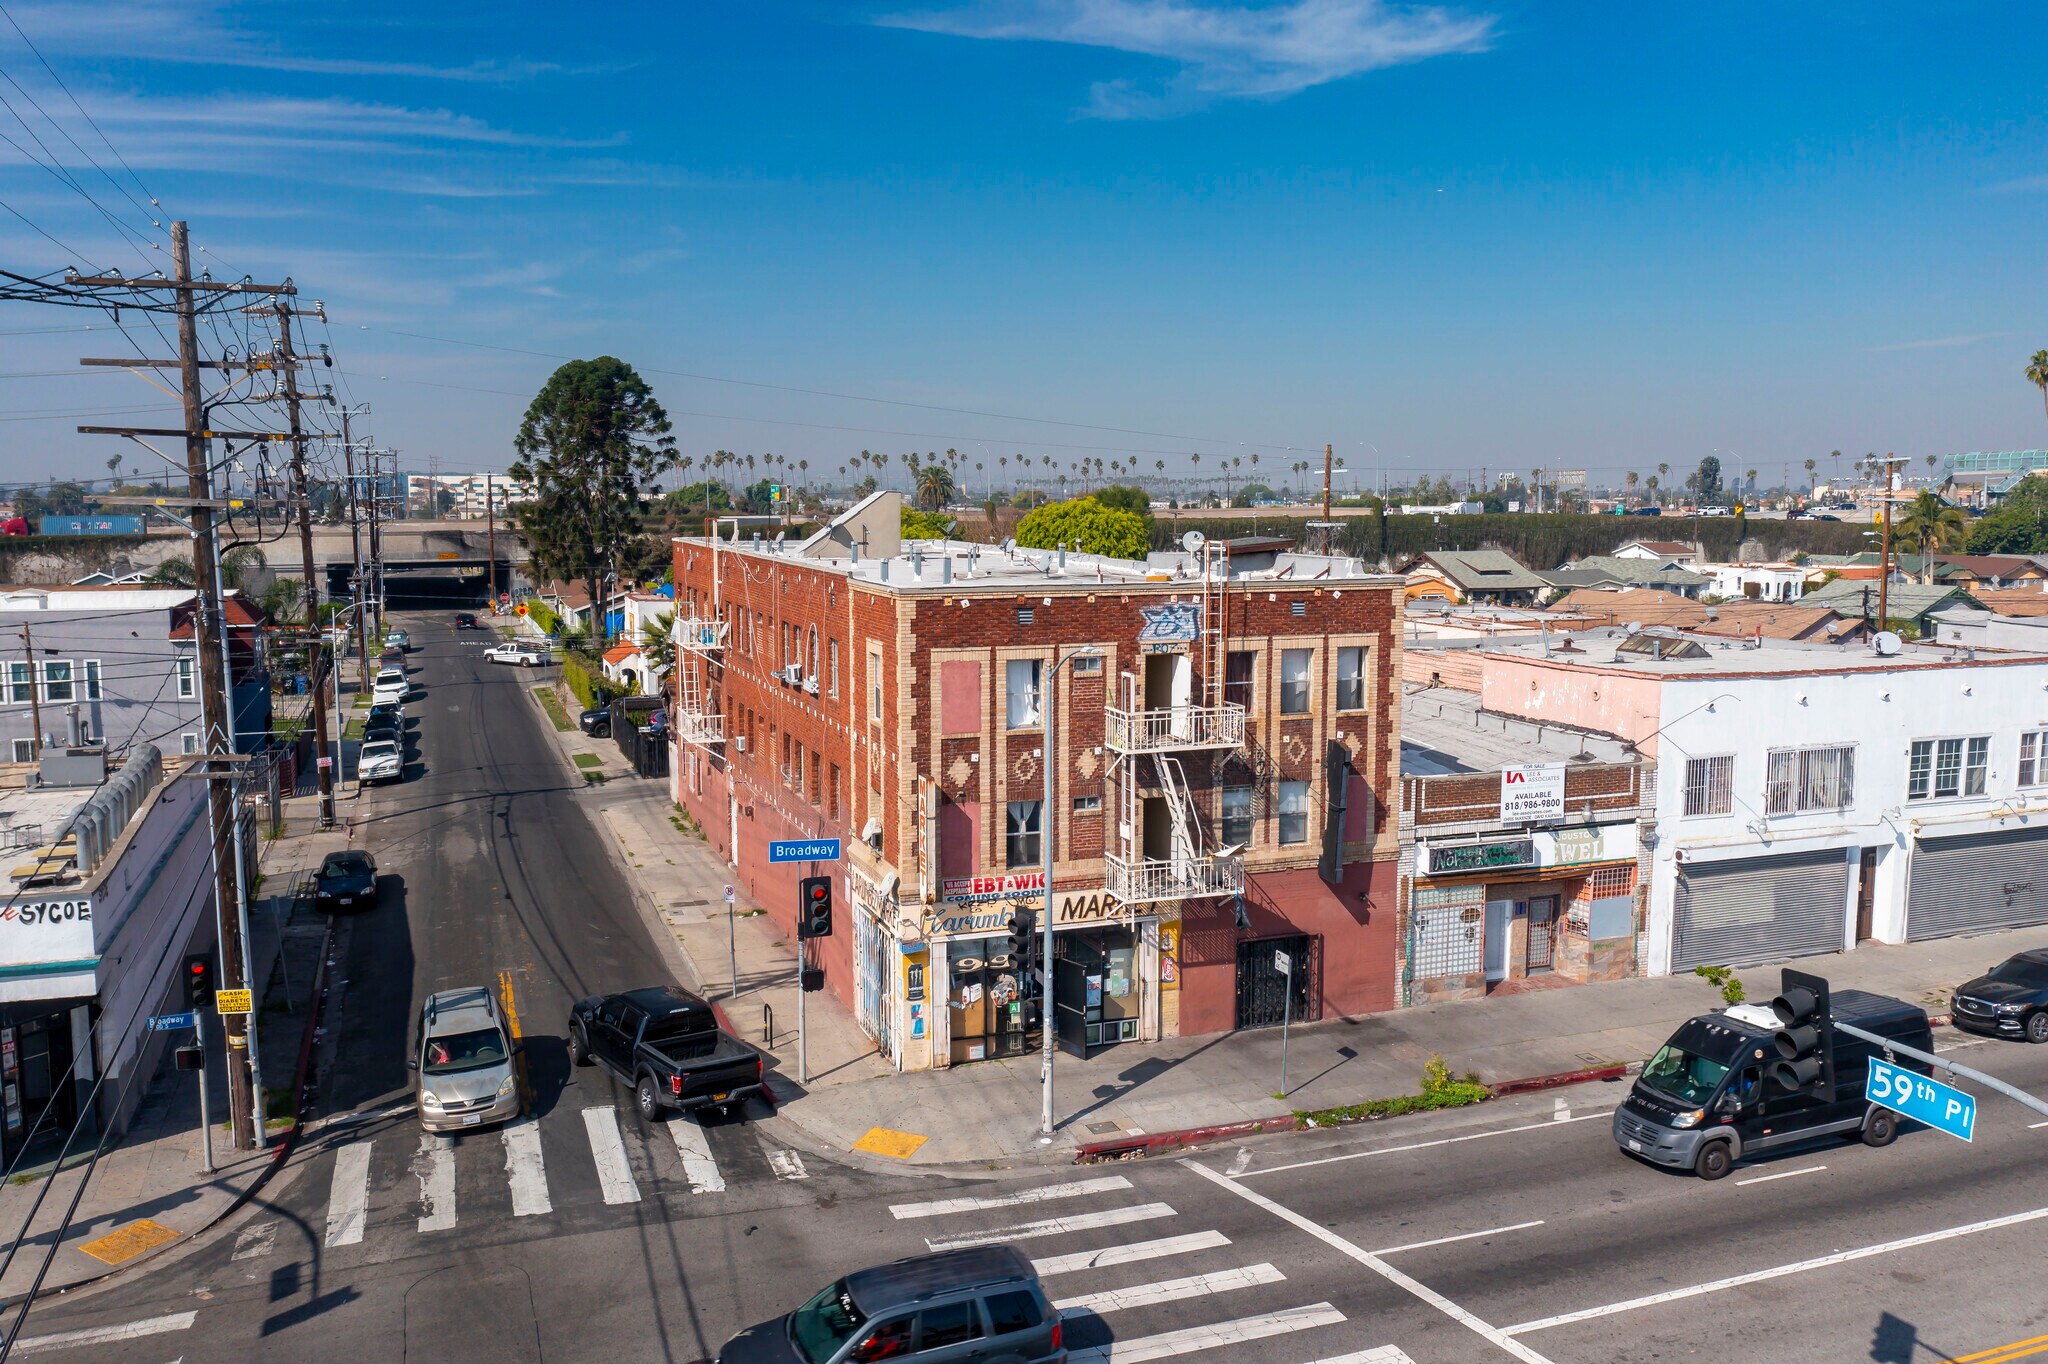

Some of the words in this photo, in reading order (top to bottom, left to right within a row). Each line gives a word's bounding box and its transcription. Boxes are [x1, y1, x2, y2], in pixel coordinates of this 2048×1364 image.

[1528, 775, 1560, 783] ASSOCIATES
[1514, 790, 1552, 800] AVAILABLE
[1504, 798, 1561, 811] 818/986-9800
[919, 778, 927, 887] MARKET
[776, 845, 834, 857] Broadway
[954, 880, 970, 888] ACCEPT
[974, 876, 1005, 894] EBT
[1007, 880, 1013, 888] &
[947, 892, 1001, 902] COMING
[1004, 889, 1045, 899] SOON!
[149, 1016, 185, 1025] Boadway
[1872, 1064, 1936, 1106] 59th
[1945, 1098, 1970, 1128] Pl
